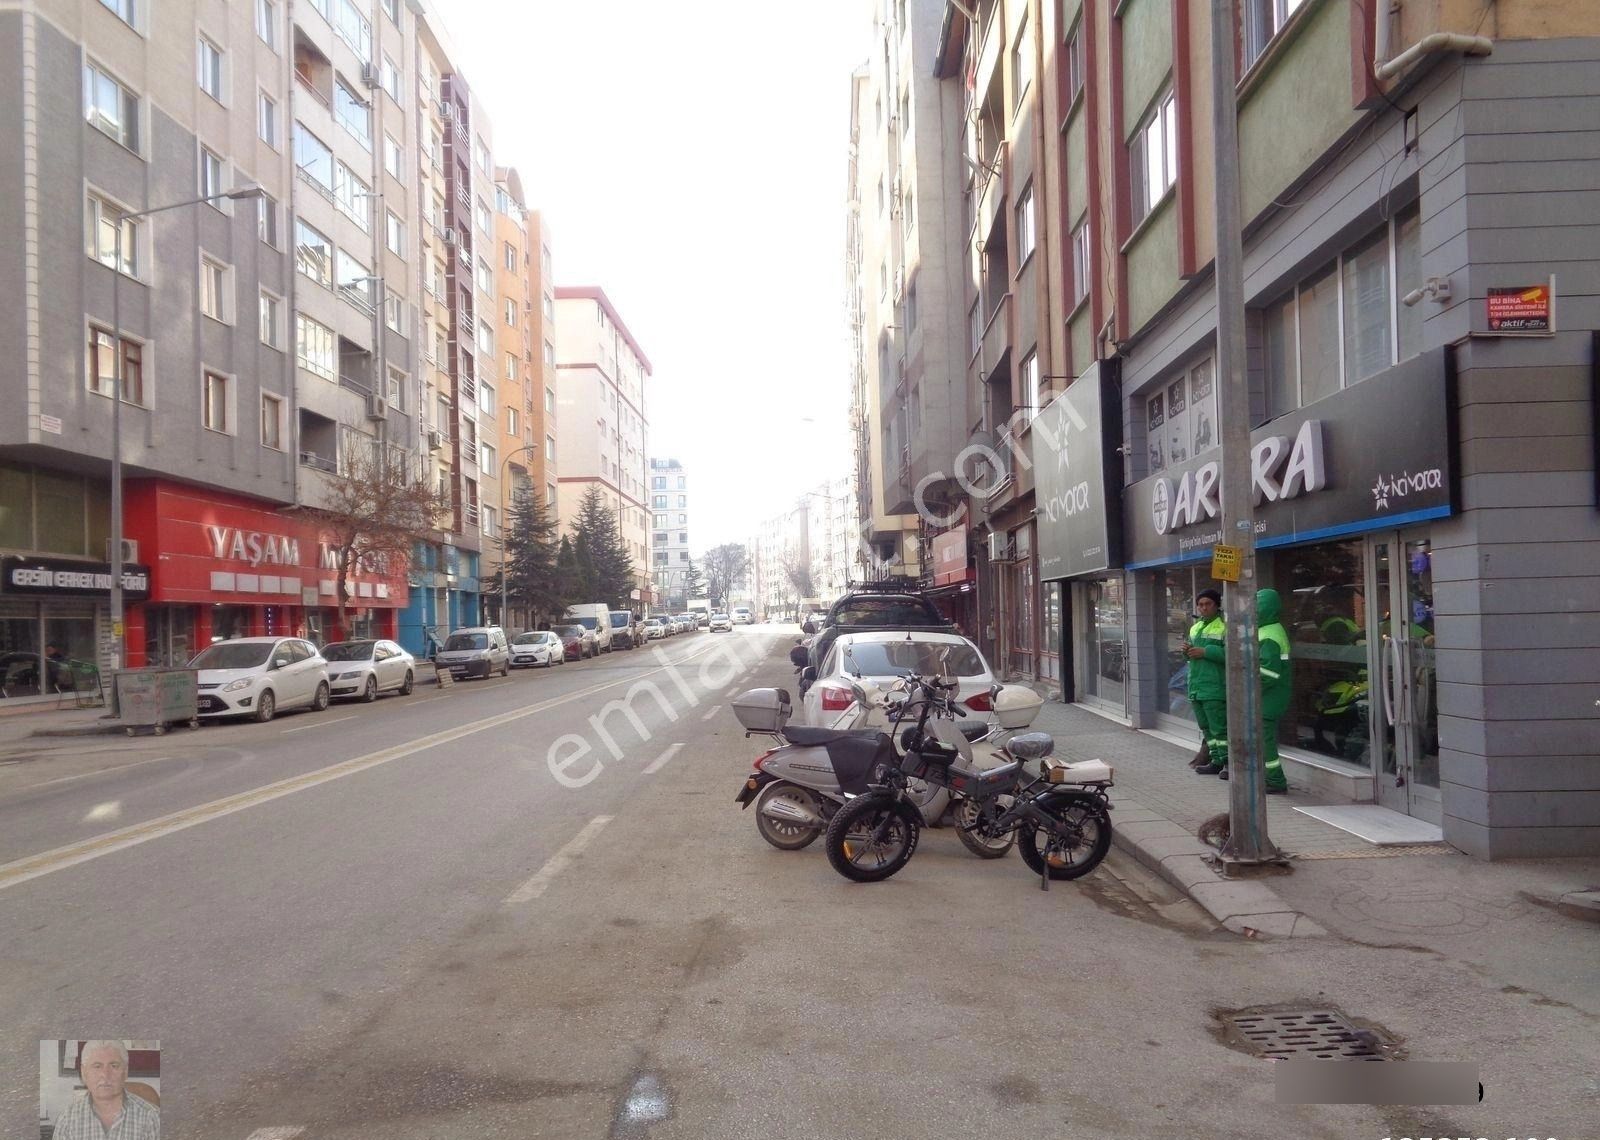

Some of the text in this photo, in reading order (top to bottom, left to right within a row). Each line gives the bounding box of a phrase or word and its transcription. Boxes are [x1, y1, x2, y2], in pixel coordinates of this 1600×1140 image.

[1503, 296, 1521, 304] BİNA
[1500, 319, 1526, 328] aktif
[1171, 420, 1326, 529] ARRA
[210, 526, 300, 567] YAŞAM
[94, 572, 147, 591] KUFÖRÜ
